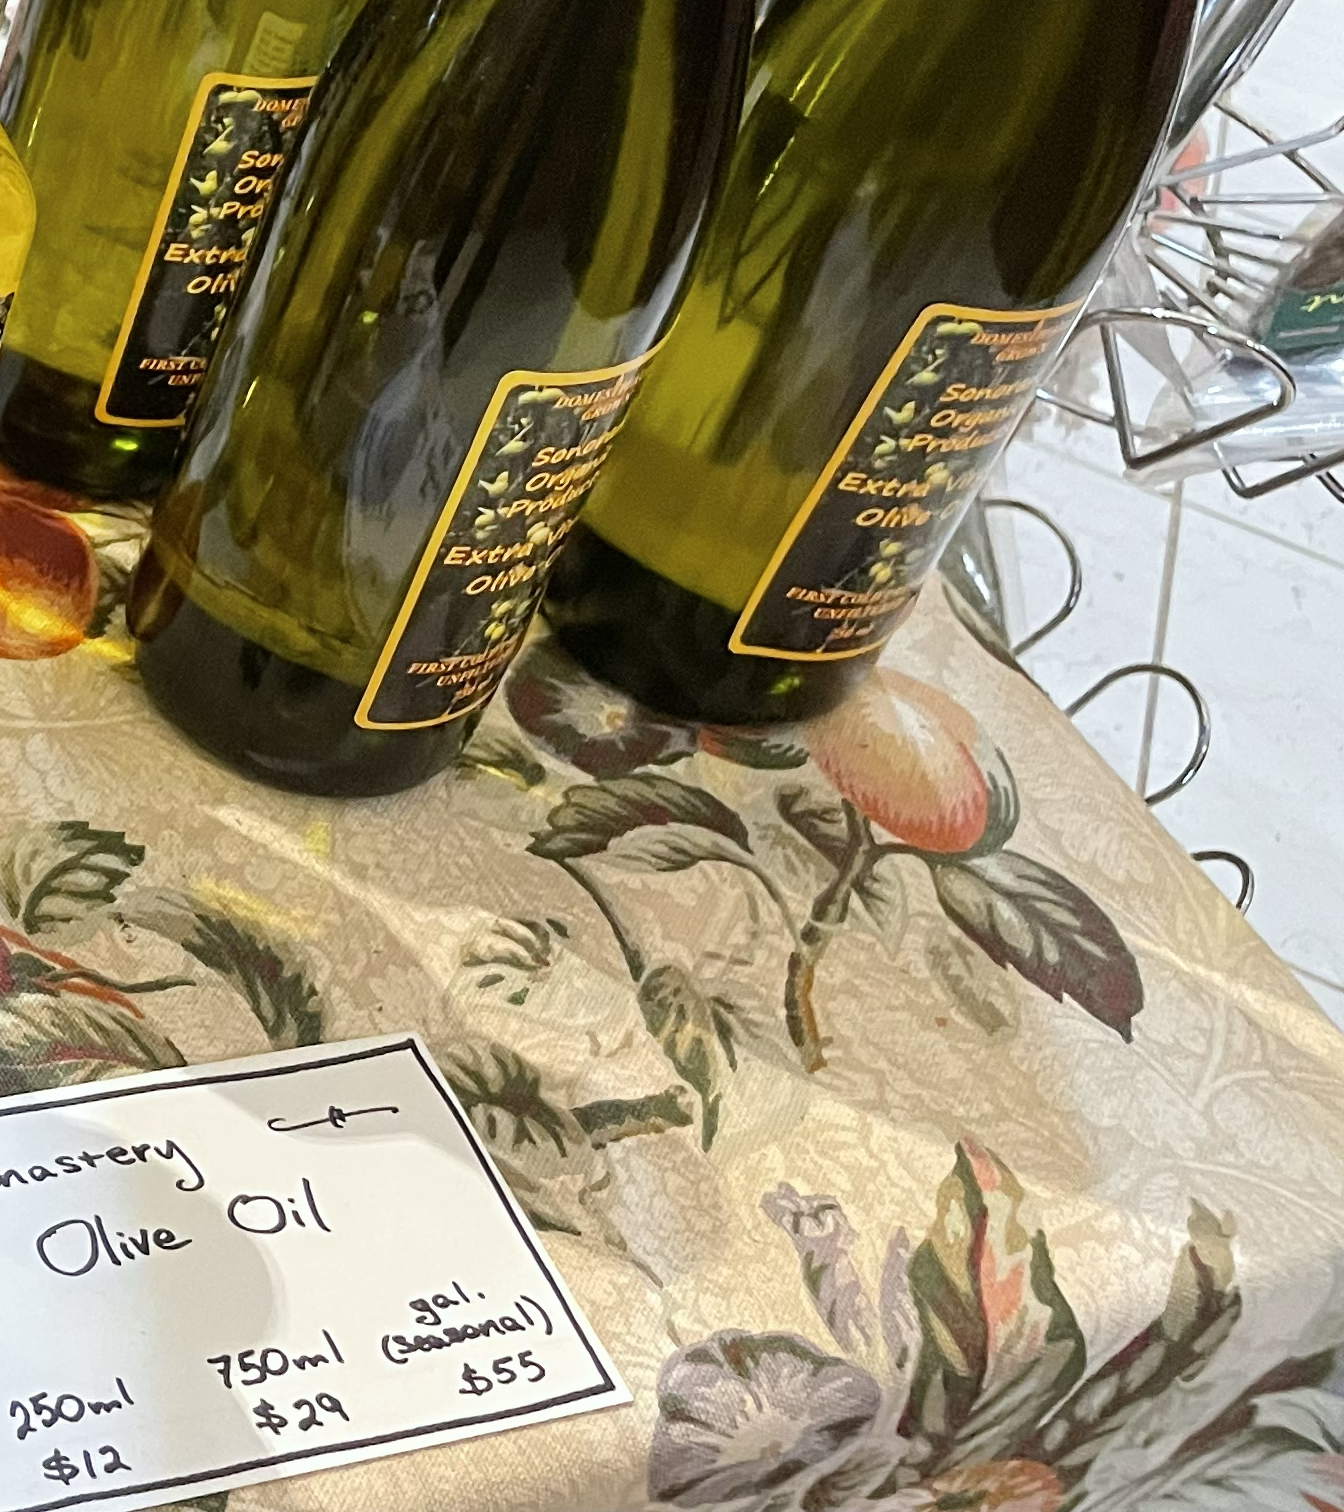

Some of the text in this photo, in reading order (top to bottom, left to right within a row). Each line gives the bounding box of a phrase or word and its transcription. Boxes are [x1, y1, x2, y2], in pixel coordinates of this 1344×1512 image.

[139, 358, 189, 371] FIRST
[838, 472, 931, 498] Extra
[444, 543, 534, 566] Extra
[466, 565, 537, 596] Olive
[36, 1178, 331, 1277] Olive Oil
[409, 1287, 487, 1326] gal.
[381, 1297, 555, 1363] (seasonal)
[8, 1330, 545, 1440] 250ml 750ml $55
[42, 1394, 350, 1484] $12 $29
